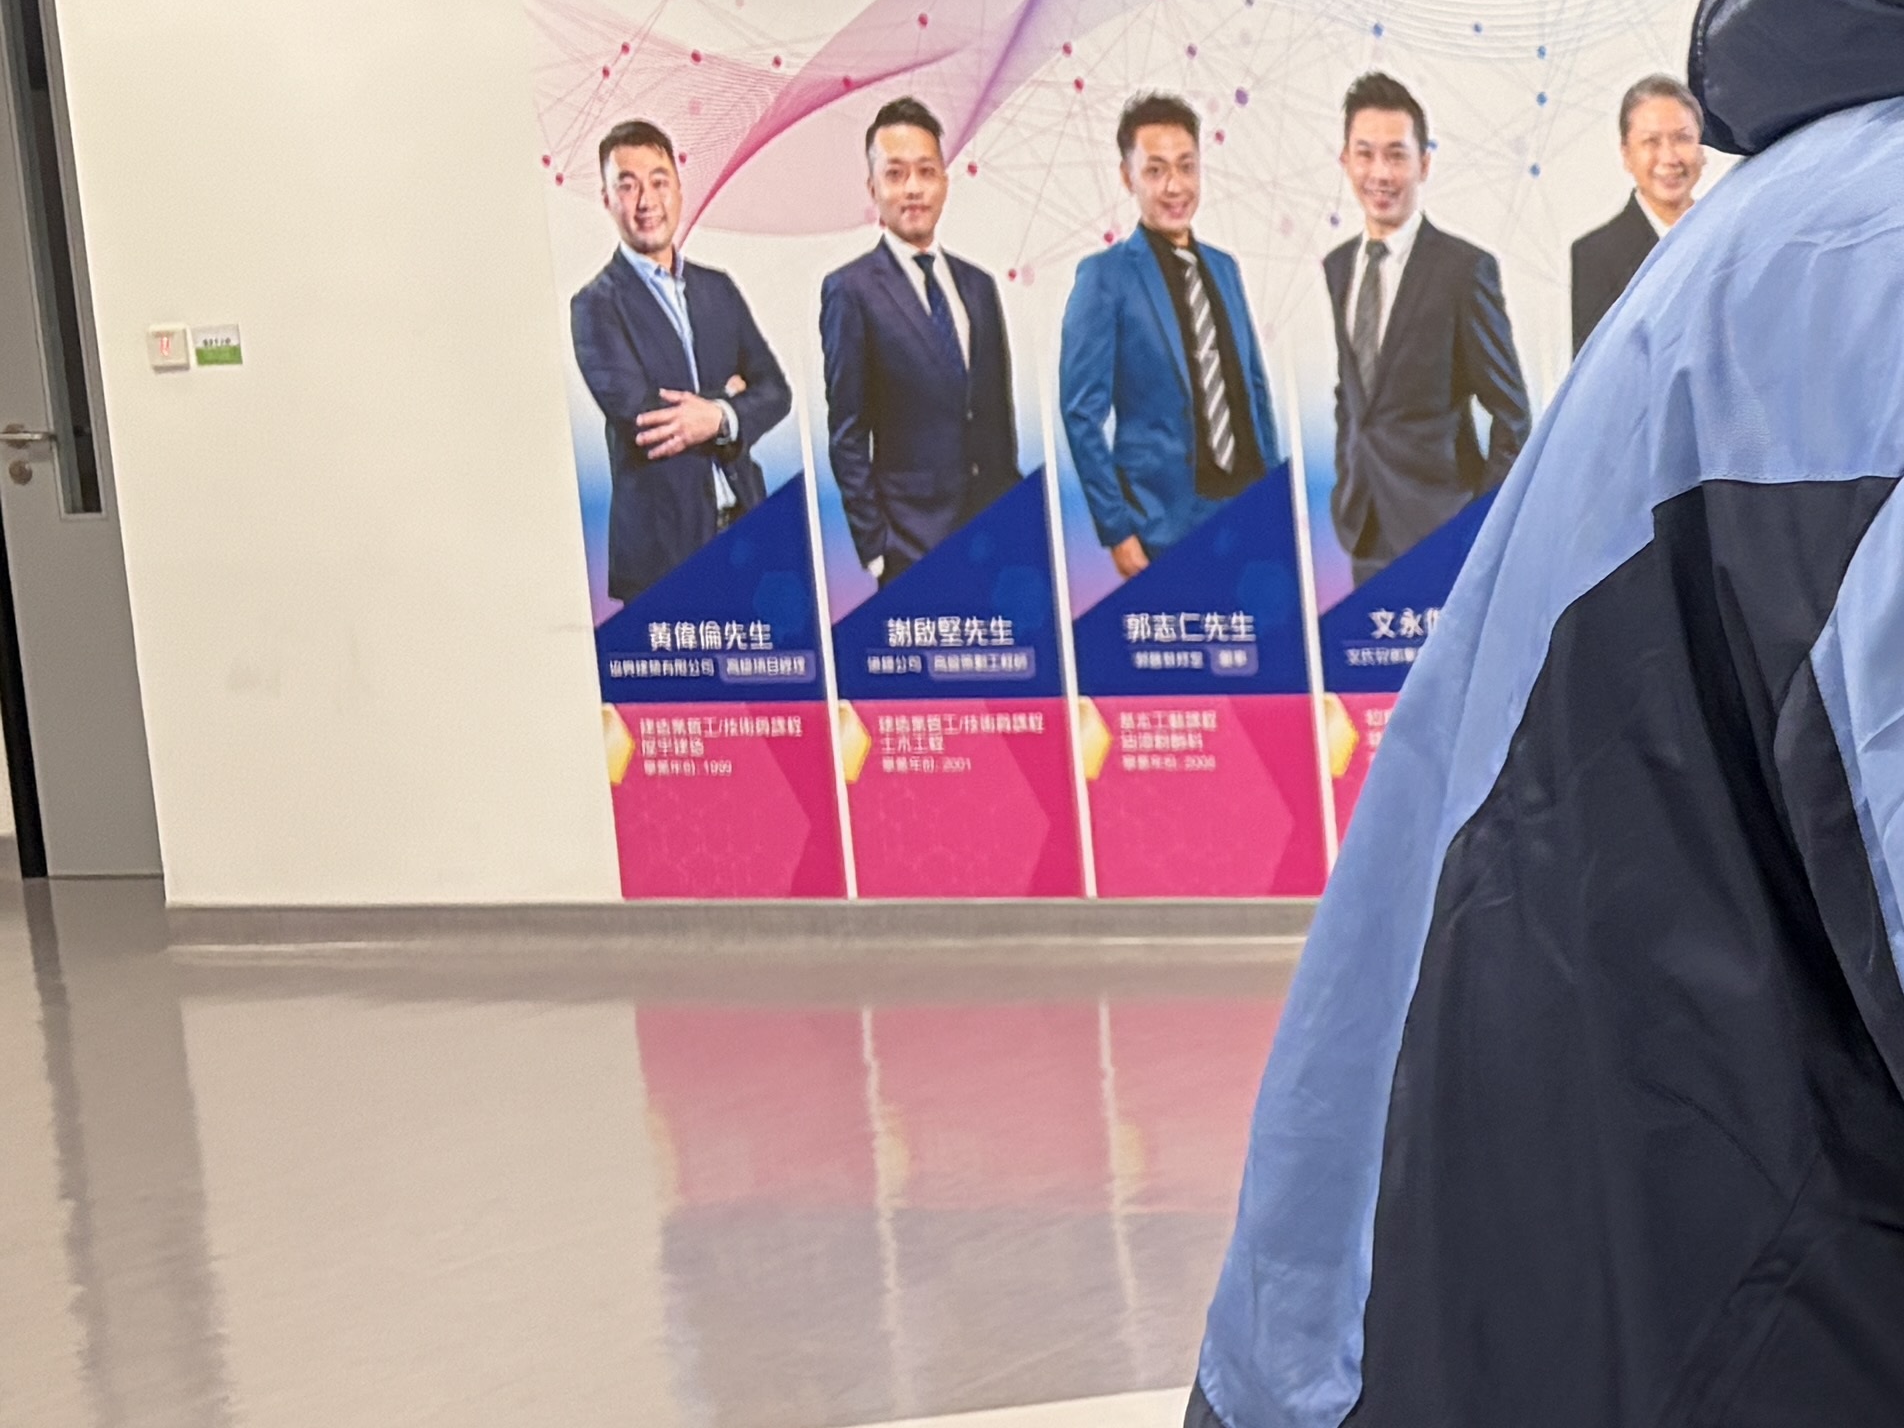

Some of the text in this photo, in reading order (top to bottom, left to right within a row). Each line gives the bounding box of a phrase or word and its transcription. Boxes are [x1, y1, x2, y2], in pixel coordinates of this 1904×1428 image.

[1124, 611, 1257, 643] 郭志仁先生
